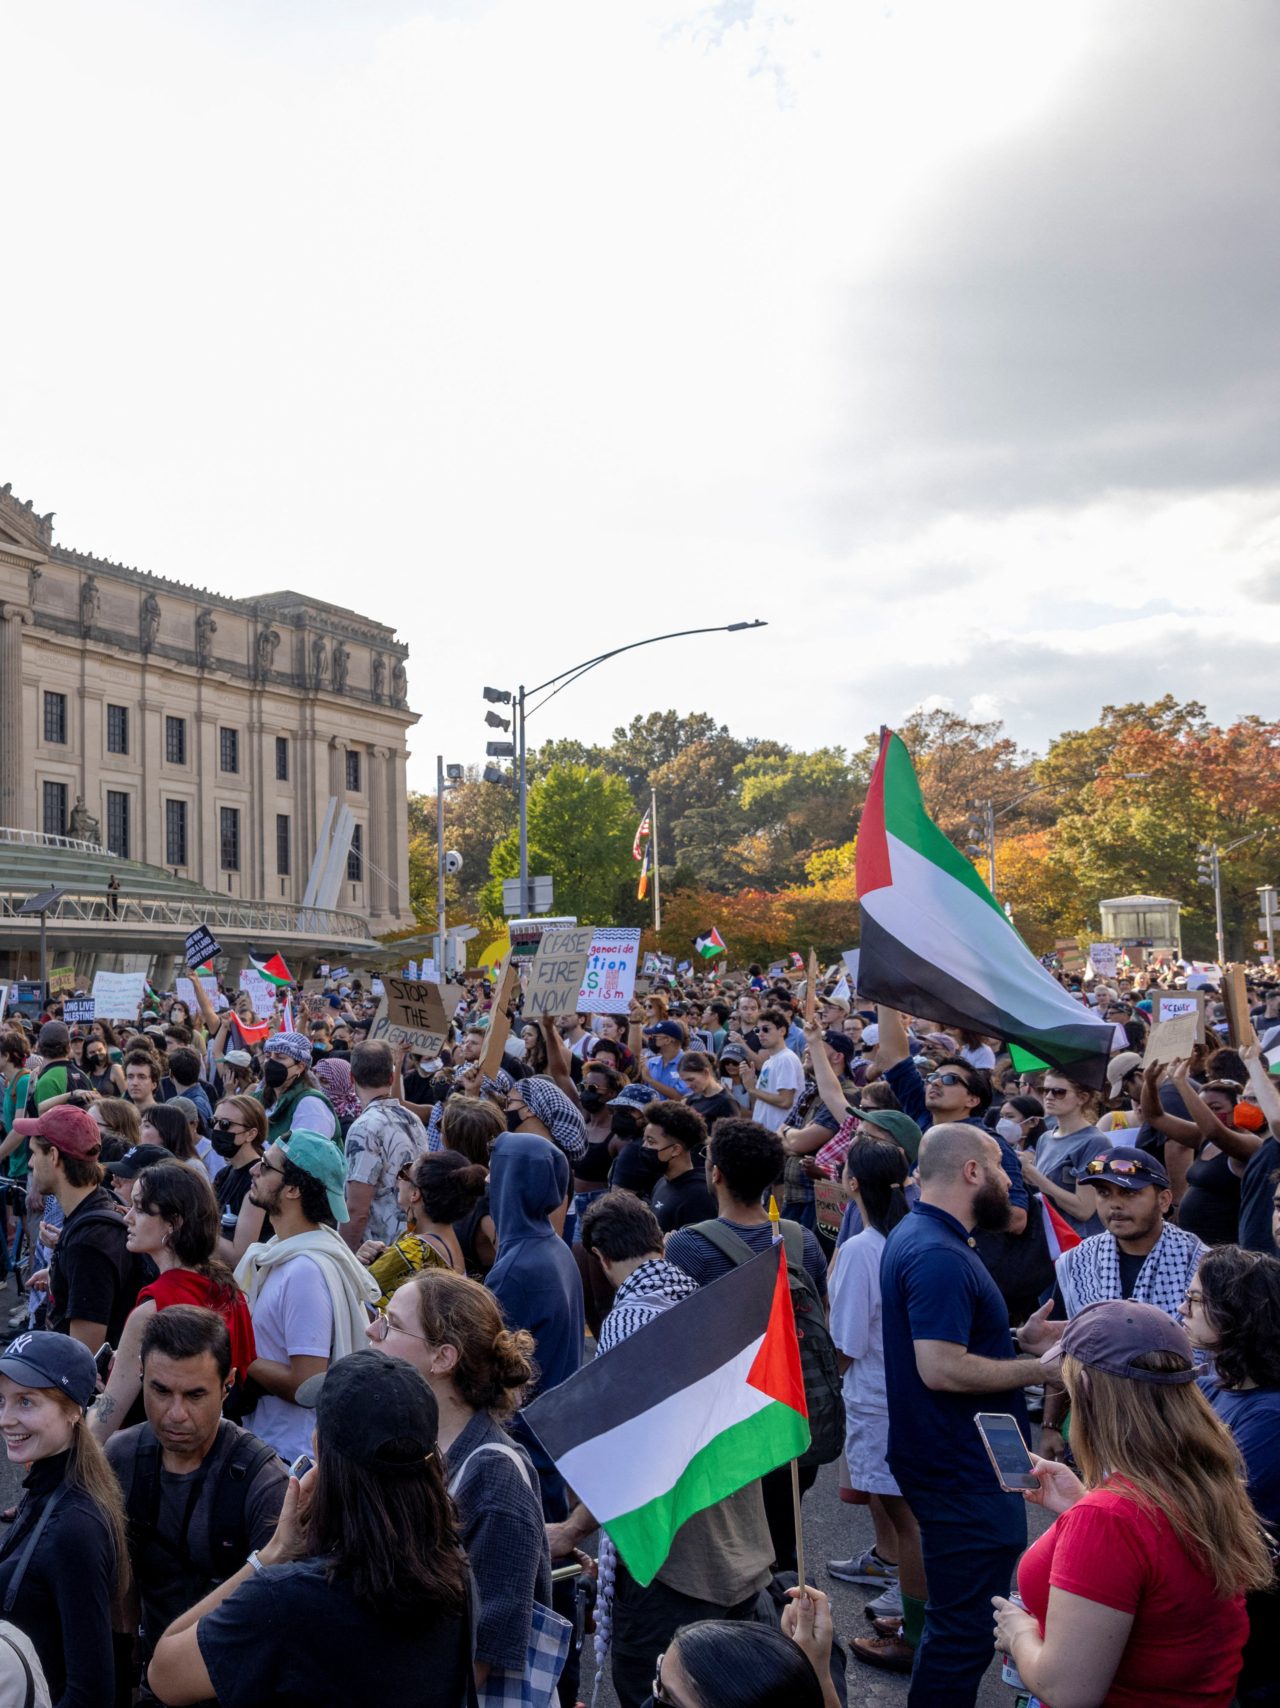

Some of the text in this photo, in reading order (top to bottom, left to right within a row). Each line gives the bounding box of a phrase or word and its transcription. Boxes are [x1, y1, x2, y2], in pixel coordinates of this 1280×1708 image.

[543, 933, 590, 955] CEASE
[590, 944, 635, 956] genocide
[537, 960, 581, 985] FIRE
[587, 956, 627, 971] tion
[390, 979, 429, 1004] STOP
[531, 987, 573, 1013] NOW
[579, 988, 625, 1000] orism
[64, 1001, 95, 1012] LONG LIVE
[64, 1011, 95, 1021] PALESTINE
[399, 1004, 431, 1029] THE
[388, 1027, 442, 1052] GENOCIDE
